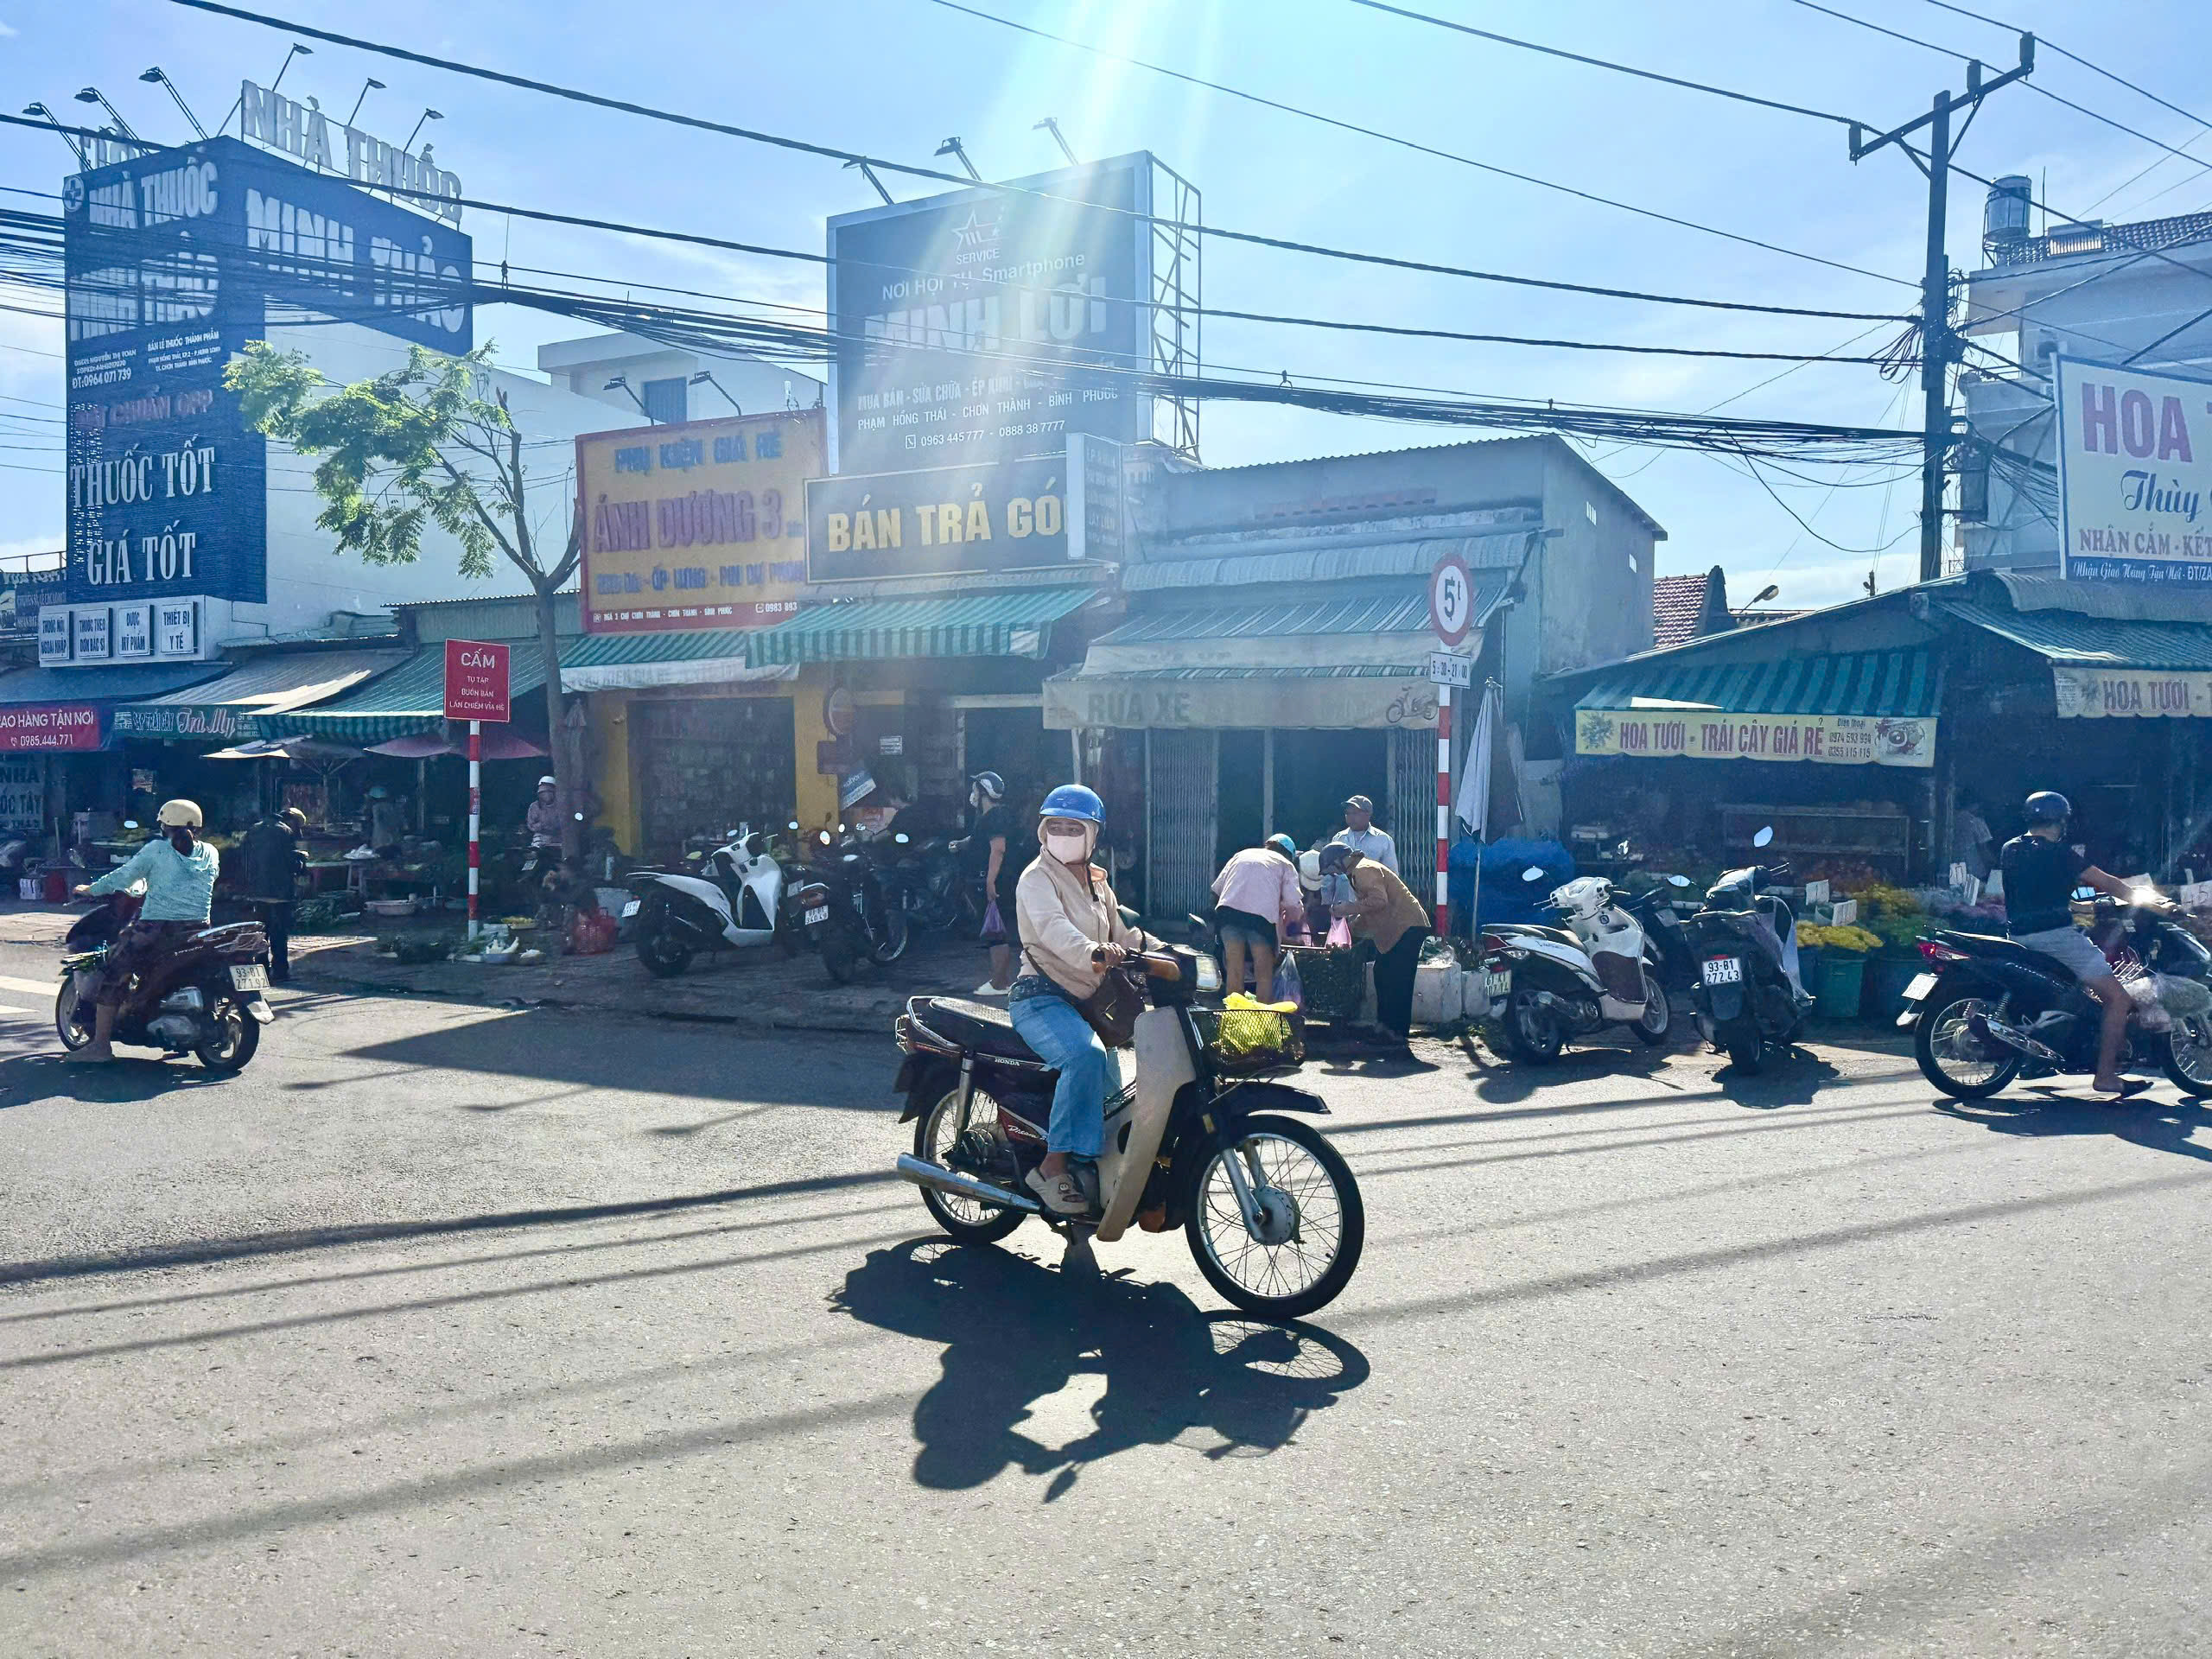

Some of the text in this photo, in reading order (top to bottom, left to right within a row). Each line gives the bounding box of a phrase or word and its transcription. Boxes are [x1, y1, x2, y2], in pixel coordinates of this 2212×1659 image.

[242, 79, 333, 169] NHÀ
[344, 124, 462, 223] THUỐC
[141, 145, 219, 226] THUỐC
[956, 249, 1001, 265] SERVICE
[882, 279, 910, 301] NƠI
[982, 253, 1085, 283] Smartphone
[104, 370, 117, 385] 071
[118, 366, 132, 382] 739
[857, 417, 886, 430] PHẠM
[893, 410, 919, 425] HỒNG
[924, 407, 947, 422] THÁI
[996, 398, 1031, 413] THÀNH
[1048, 391, 1072, 407] BÌNH
[2082, 383, 2193, 463] HOA
[921, 420, 1065, 447] 0963 445 777 0888 38 7777
[70, 433, 215, 508] THUỐC TỐT
[2120, 469, 2202, 523] Thùy
[761, 489, 782, 539] 3
[828, 477, 1068, 552] BÁN TRẢ GÓ
[87, 520, 196, 585] GIÁ TỐT
[2080, 524, 2130, 557] NHẬN
[2075, 562, 2098, 580] Nhận
[2101, 563, 2120, 580] Giao
[163, 608, 190, 627] THIẾT BỊ
[766, 602, 797, 613] 0983 893
[169, 631, 184, 650] Y TẾ
[461, 648, 495, 669] CẤM
[2103, 680, 2143, 710] HOA
[2148, 679, 2190, 710] TƯƠI
[0, 709, 93, 729] AO HÀNG TẬN NƠI
[20, 734, 73, 747] 0985.444.771
[1620, 717, 1825, 755] HOA TƯƠI TRÁI CÂY GIÁ RẺ
[1707, 970, 1739, 983] 272.43
[1708, 960, 1733, 972] 93-B1
[995, 1058, 1020, 1066] HONDA
